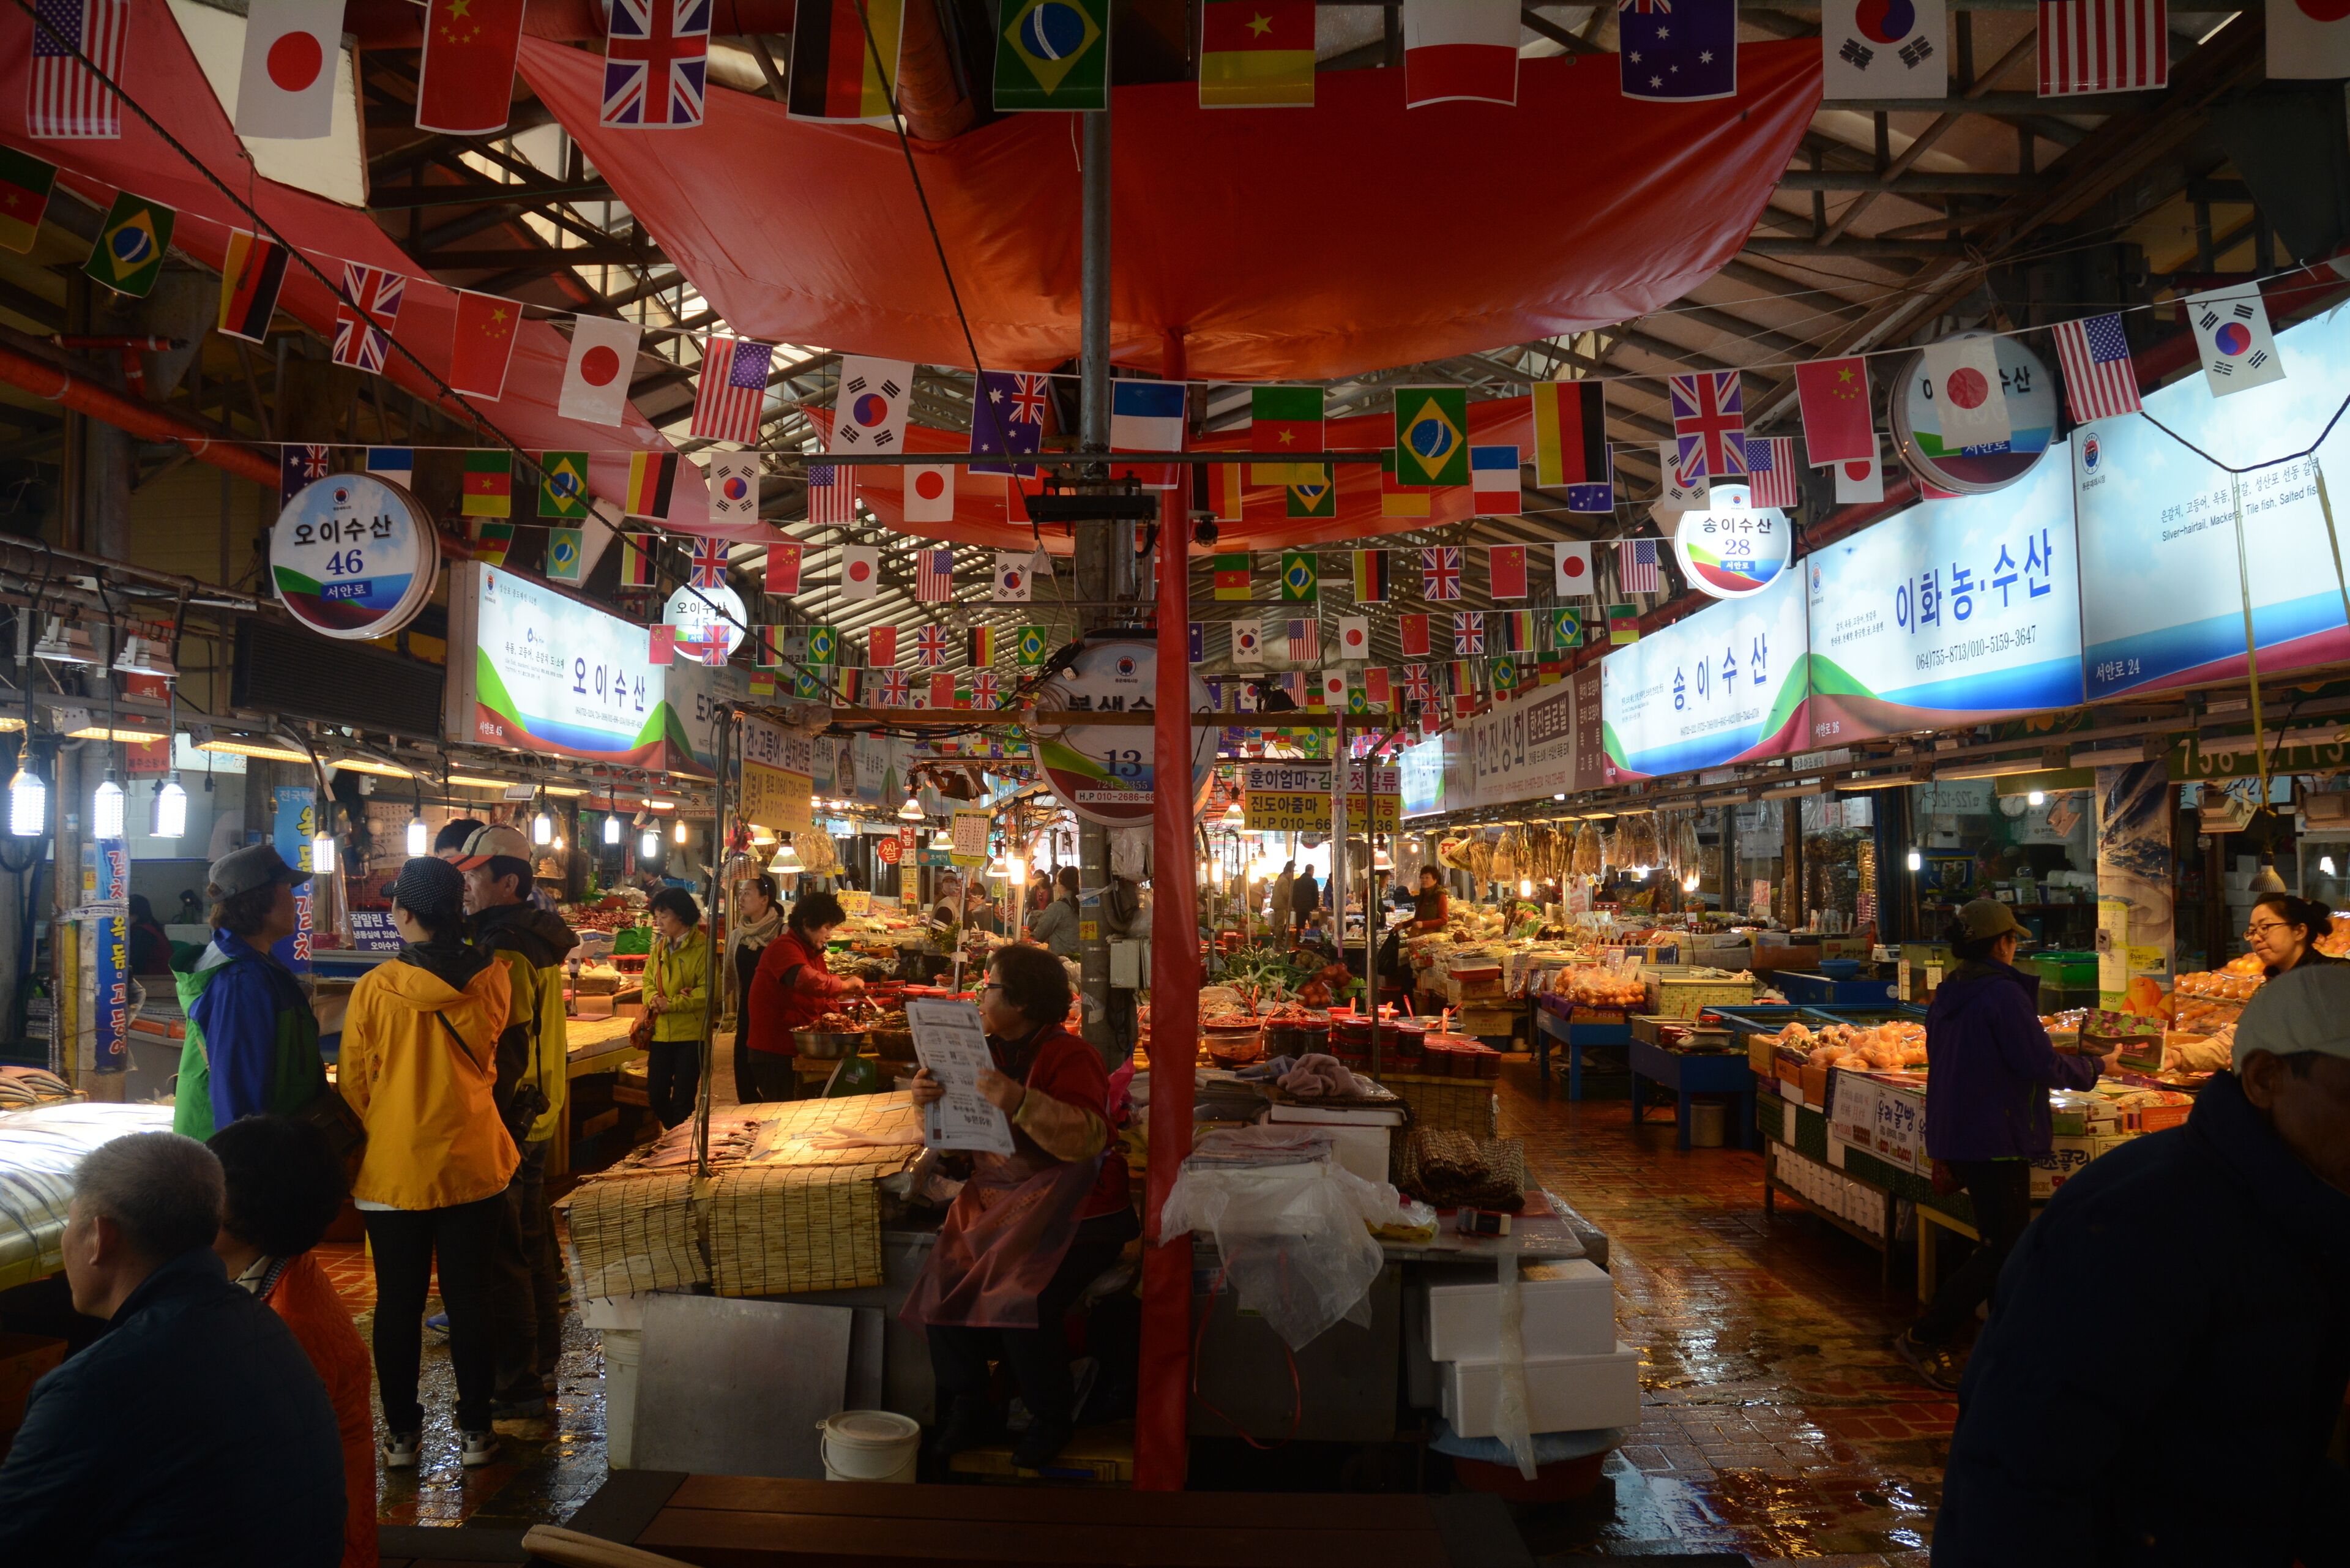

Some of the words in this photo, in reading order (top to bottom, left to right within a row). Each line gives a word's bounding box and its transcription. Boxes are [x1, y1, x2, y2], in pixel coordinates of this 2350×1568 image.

[2187, 495, 2210, 514] 고등어,
[2213, 489, 2230, 506] 옥돔,
[2256, 473, 2279, 493] 성산포
[2162, 520, 2209, 541] Silver-hairtail,
[2247, 504, 2259, 516] Tile
[2261, 499, 2277, 512] fish,
[2280, 488, 2305, 506] Salted
[2307, 484, 2319, 497] fis
[294, 515, 392, 546] 오이수산
[1703, 518, 1772, 534] 송이수산
[1725, 539, 1751, 555] 28
[326, 549, 364, 575] 46
[1726, 561, 1750, 570] 서안로
[327, 584, 367, 599] 서안로
[692, 618, 710, 630] 45
[1916, 625, 2036, 671] 064)755-8713/010-5159-3647
[1673, 633, 1767, 711] 송이수산
[2096, 661, 2125, 682] 서안로
[2128, 658, 2140, 676] 24
[573, 657, 645, 712] 오이수산
[479, 721, 495, 736] 서안로
[496, 725, 502, 736] 45
[1529, 698, 1567, 741] 한진글로벌
[1816, 723, 1831, 738] 서안로
[1832, 721, 1840, 734] 26
[1477, 710, 1524, 776] 한진상회
[1103, 750, 1144, 777] 13
[1097, 780, 1149, 790] 724-2355
[1251, 796, 1318, 815] 진도아줌마
[1252, 818, 1280, 829] H.P
[881, 841, 900, 862] 쌀
[350, 913, 384, 928] 잘말린
[371, 941, 400, 950] 오이수산
